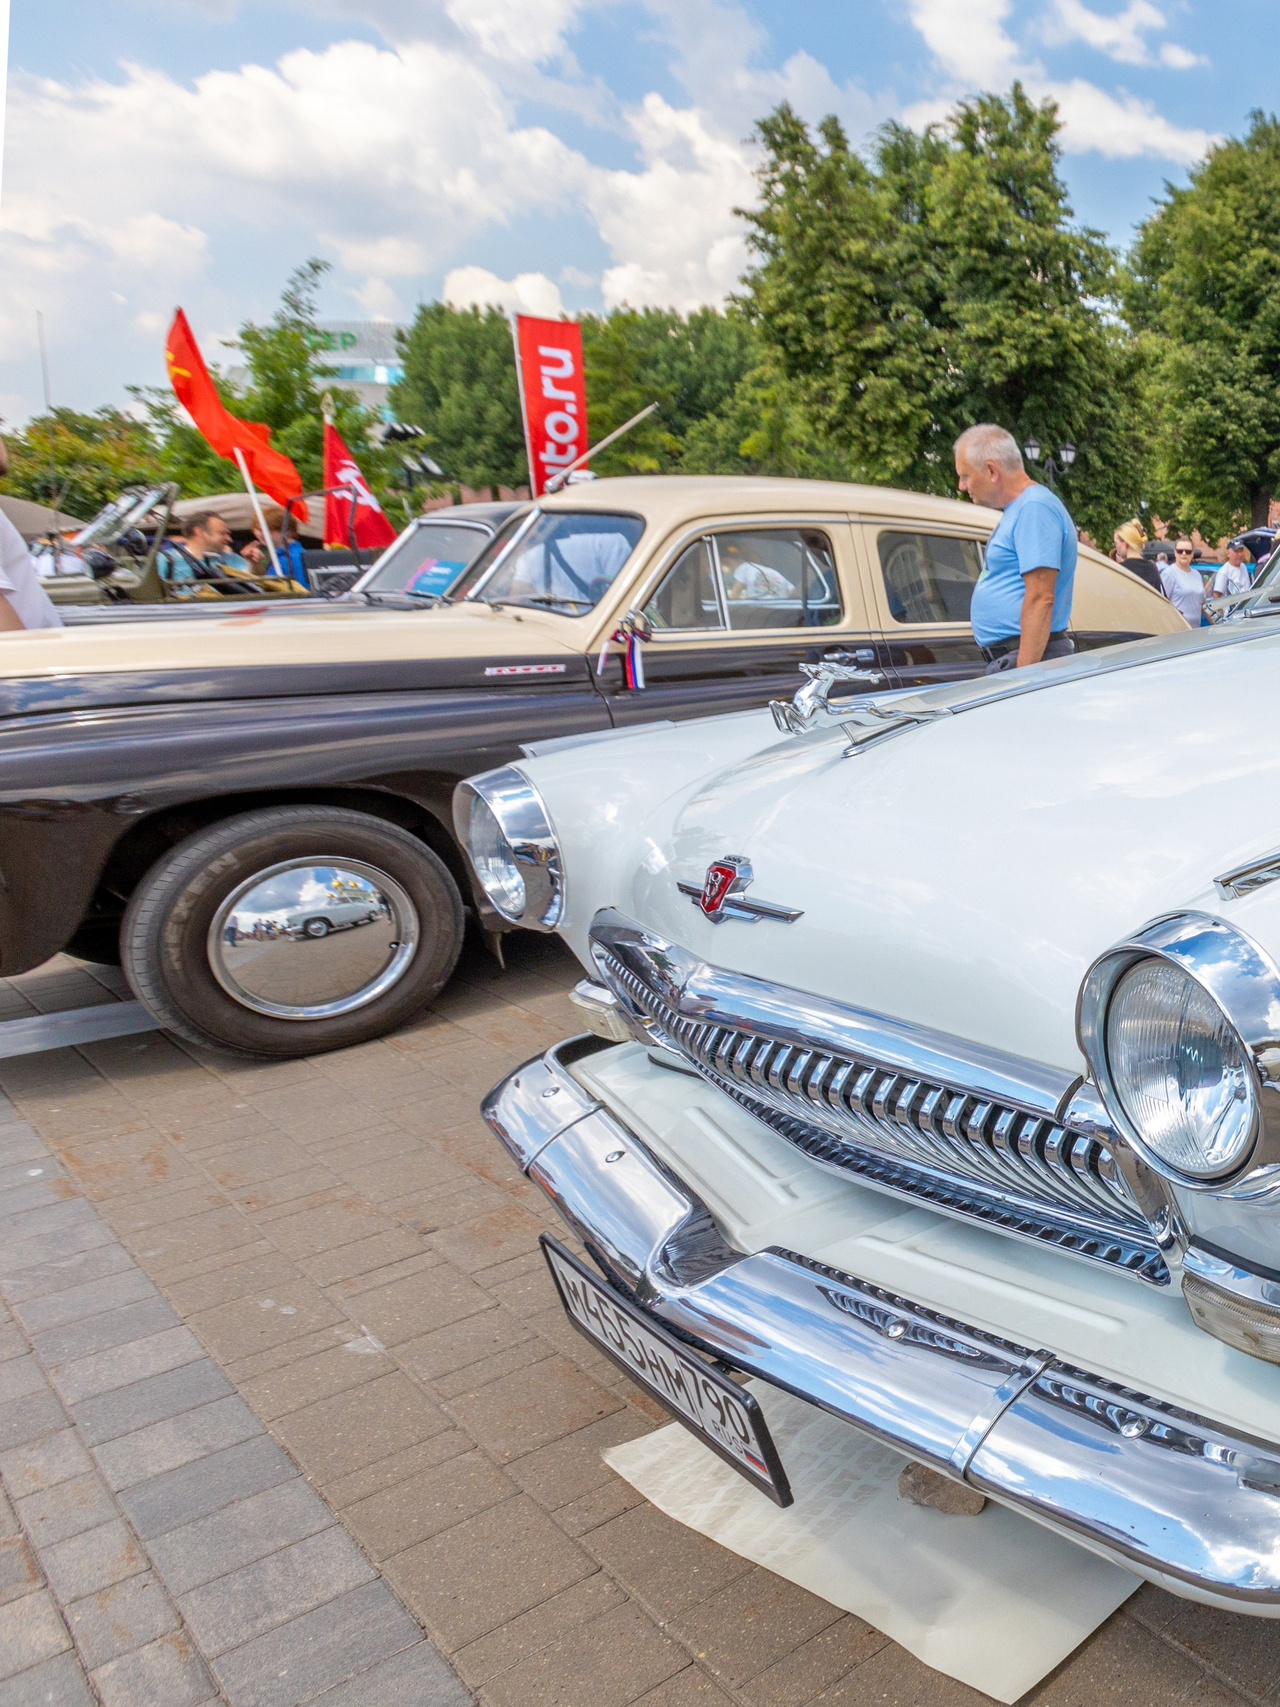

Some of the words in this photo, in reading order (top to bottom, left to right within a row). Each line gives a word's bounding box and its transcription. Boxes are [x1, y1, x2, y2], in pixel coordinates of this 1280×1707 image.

[538, 345, 579, 475] to.ru
[678, 1358, 751, 1445] 790
[711, 1419, 744, 1455] RUS
